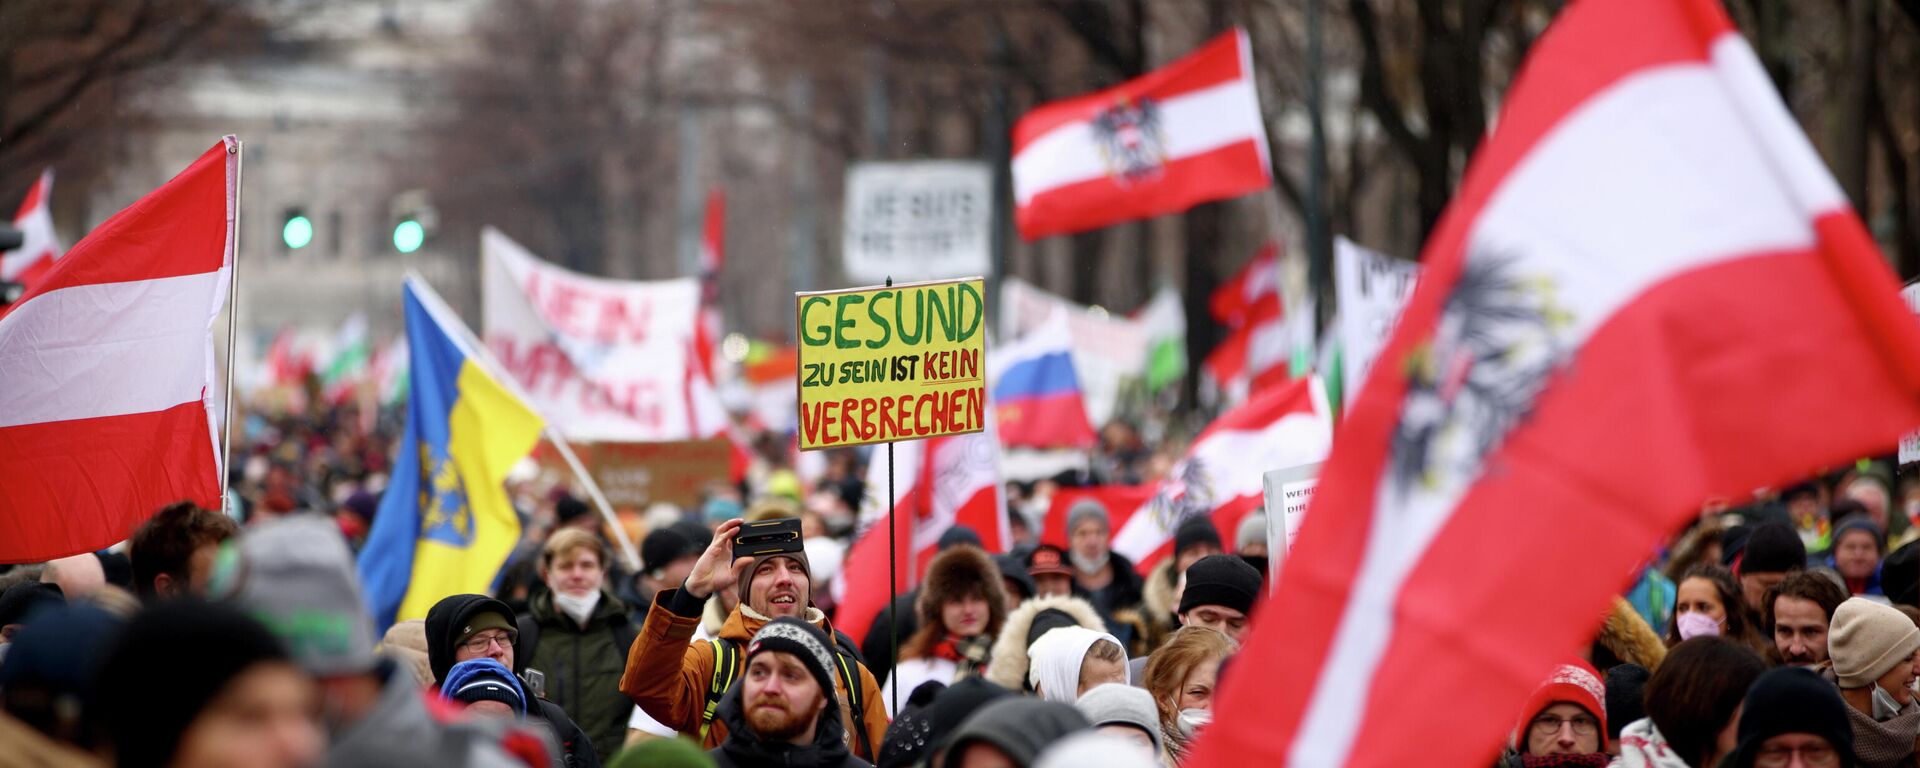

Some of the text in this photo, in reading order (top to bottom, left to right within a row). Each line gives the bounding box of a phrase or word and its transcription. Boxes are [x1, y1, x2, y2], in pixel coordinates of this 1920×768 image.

[801, 283, 983, 349] GESUND
[803, 348, 978, 387] ZU SEIN IST KEIN
[802, 387, 984, 445] VERBRECHEN
